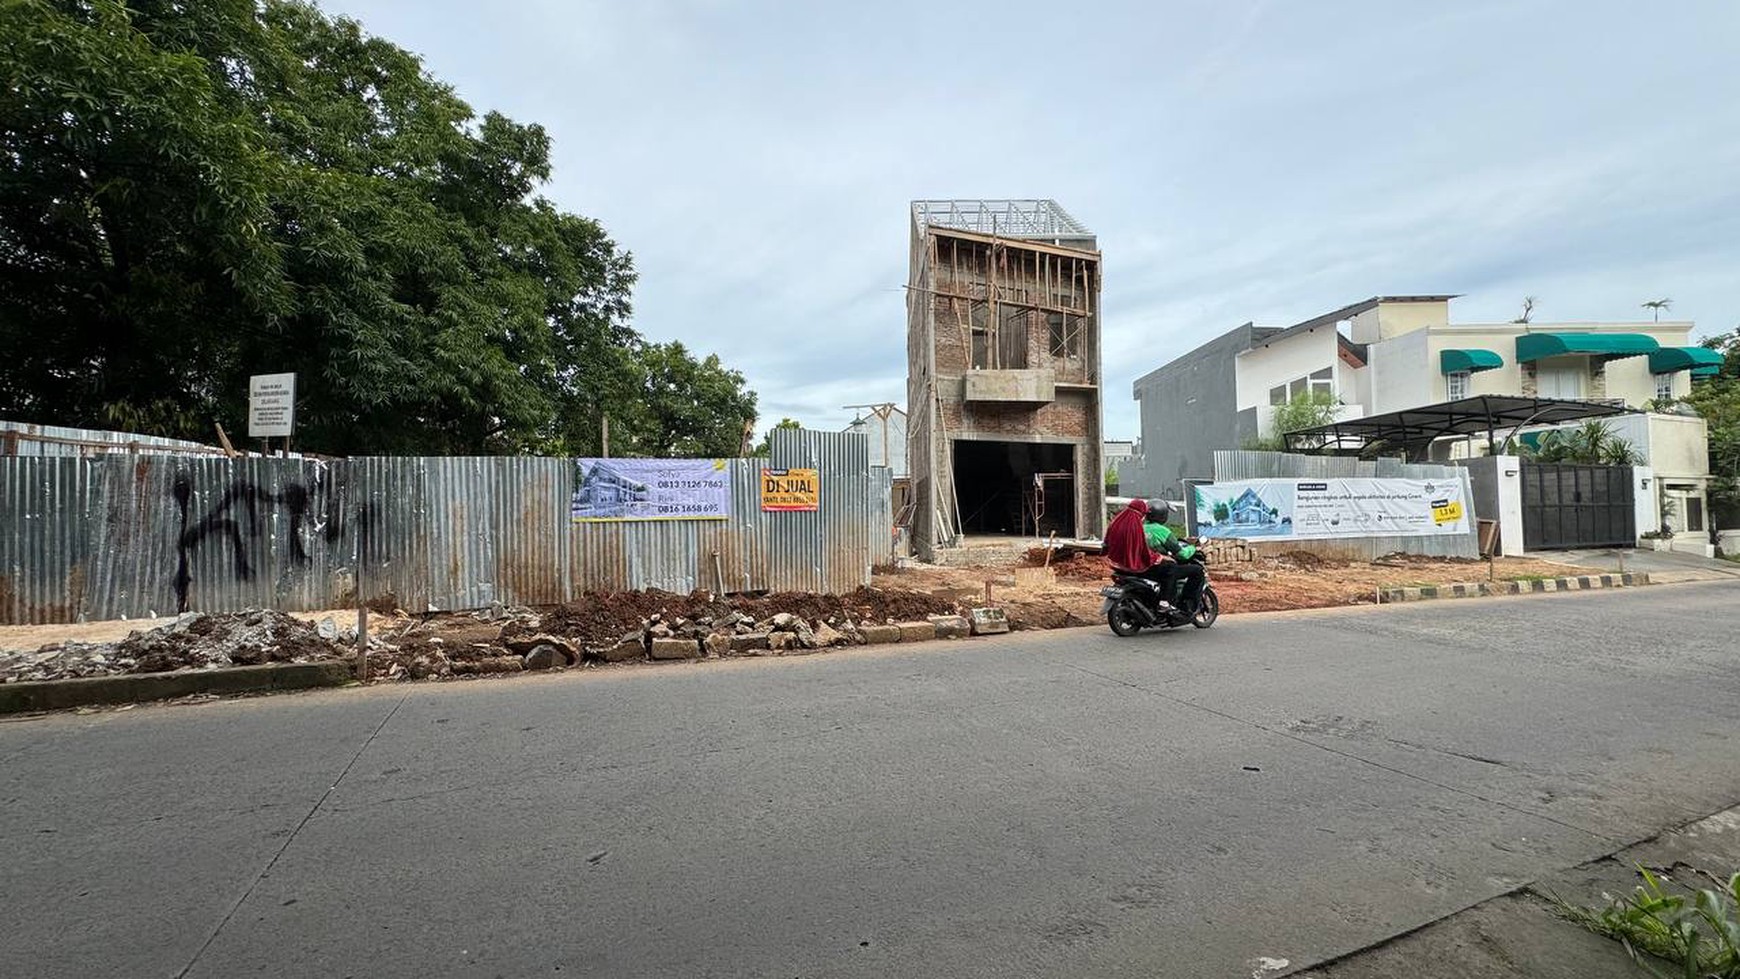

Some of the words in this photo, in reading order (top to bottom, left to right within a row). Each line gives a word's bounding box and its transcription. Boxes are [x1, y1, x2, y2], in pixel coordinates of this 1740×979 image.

[766, 479, 780, 493] DI
[784, 479, 814, 493] JUAL
[657, 504, 680, 513] 0816
[703, 503, 719, 512] 695
